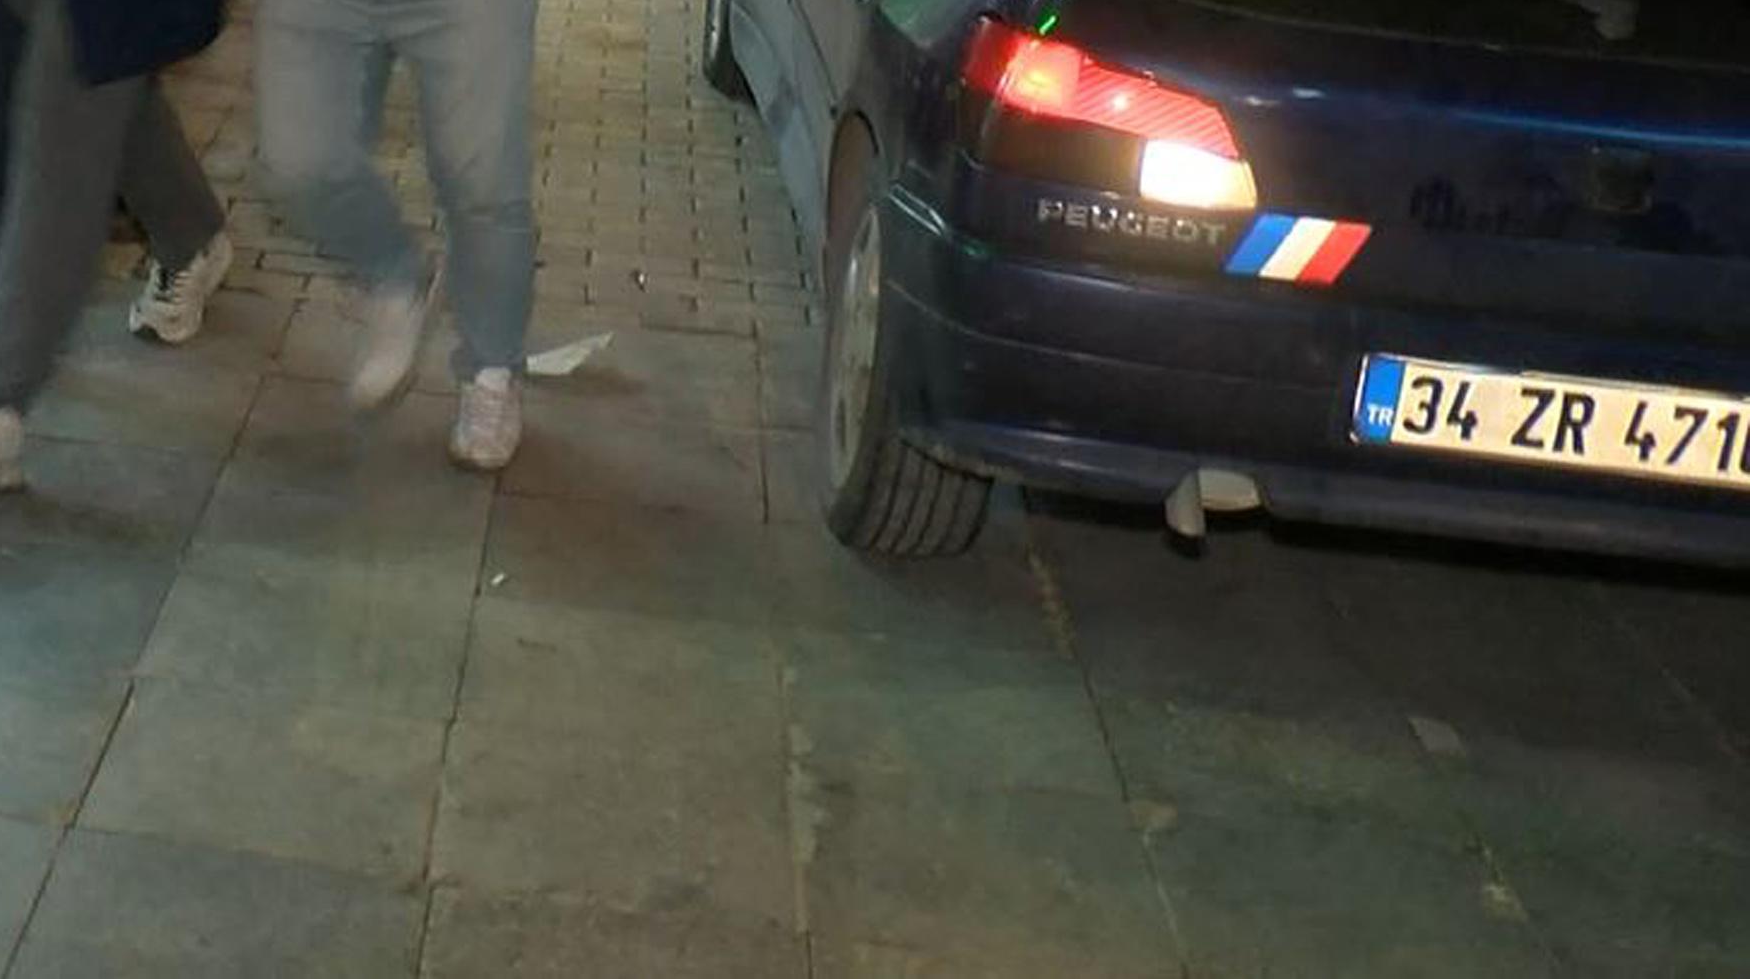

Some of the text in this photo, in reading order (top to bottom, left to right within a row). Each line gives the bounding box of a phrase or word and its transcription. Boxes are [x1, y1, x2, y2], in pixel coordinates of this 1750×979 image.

[1038, 198, 1227, 245] PEUGEOT
[1366, 403, 1393, 427] TR
[1402, 376, 1479, 442] 34
[1510, 386, 1596, 456] ZR
